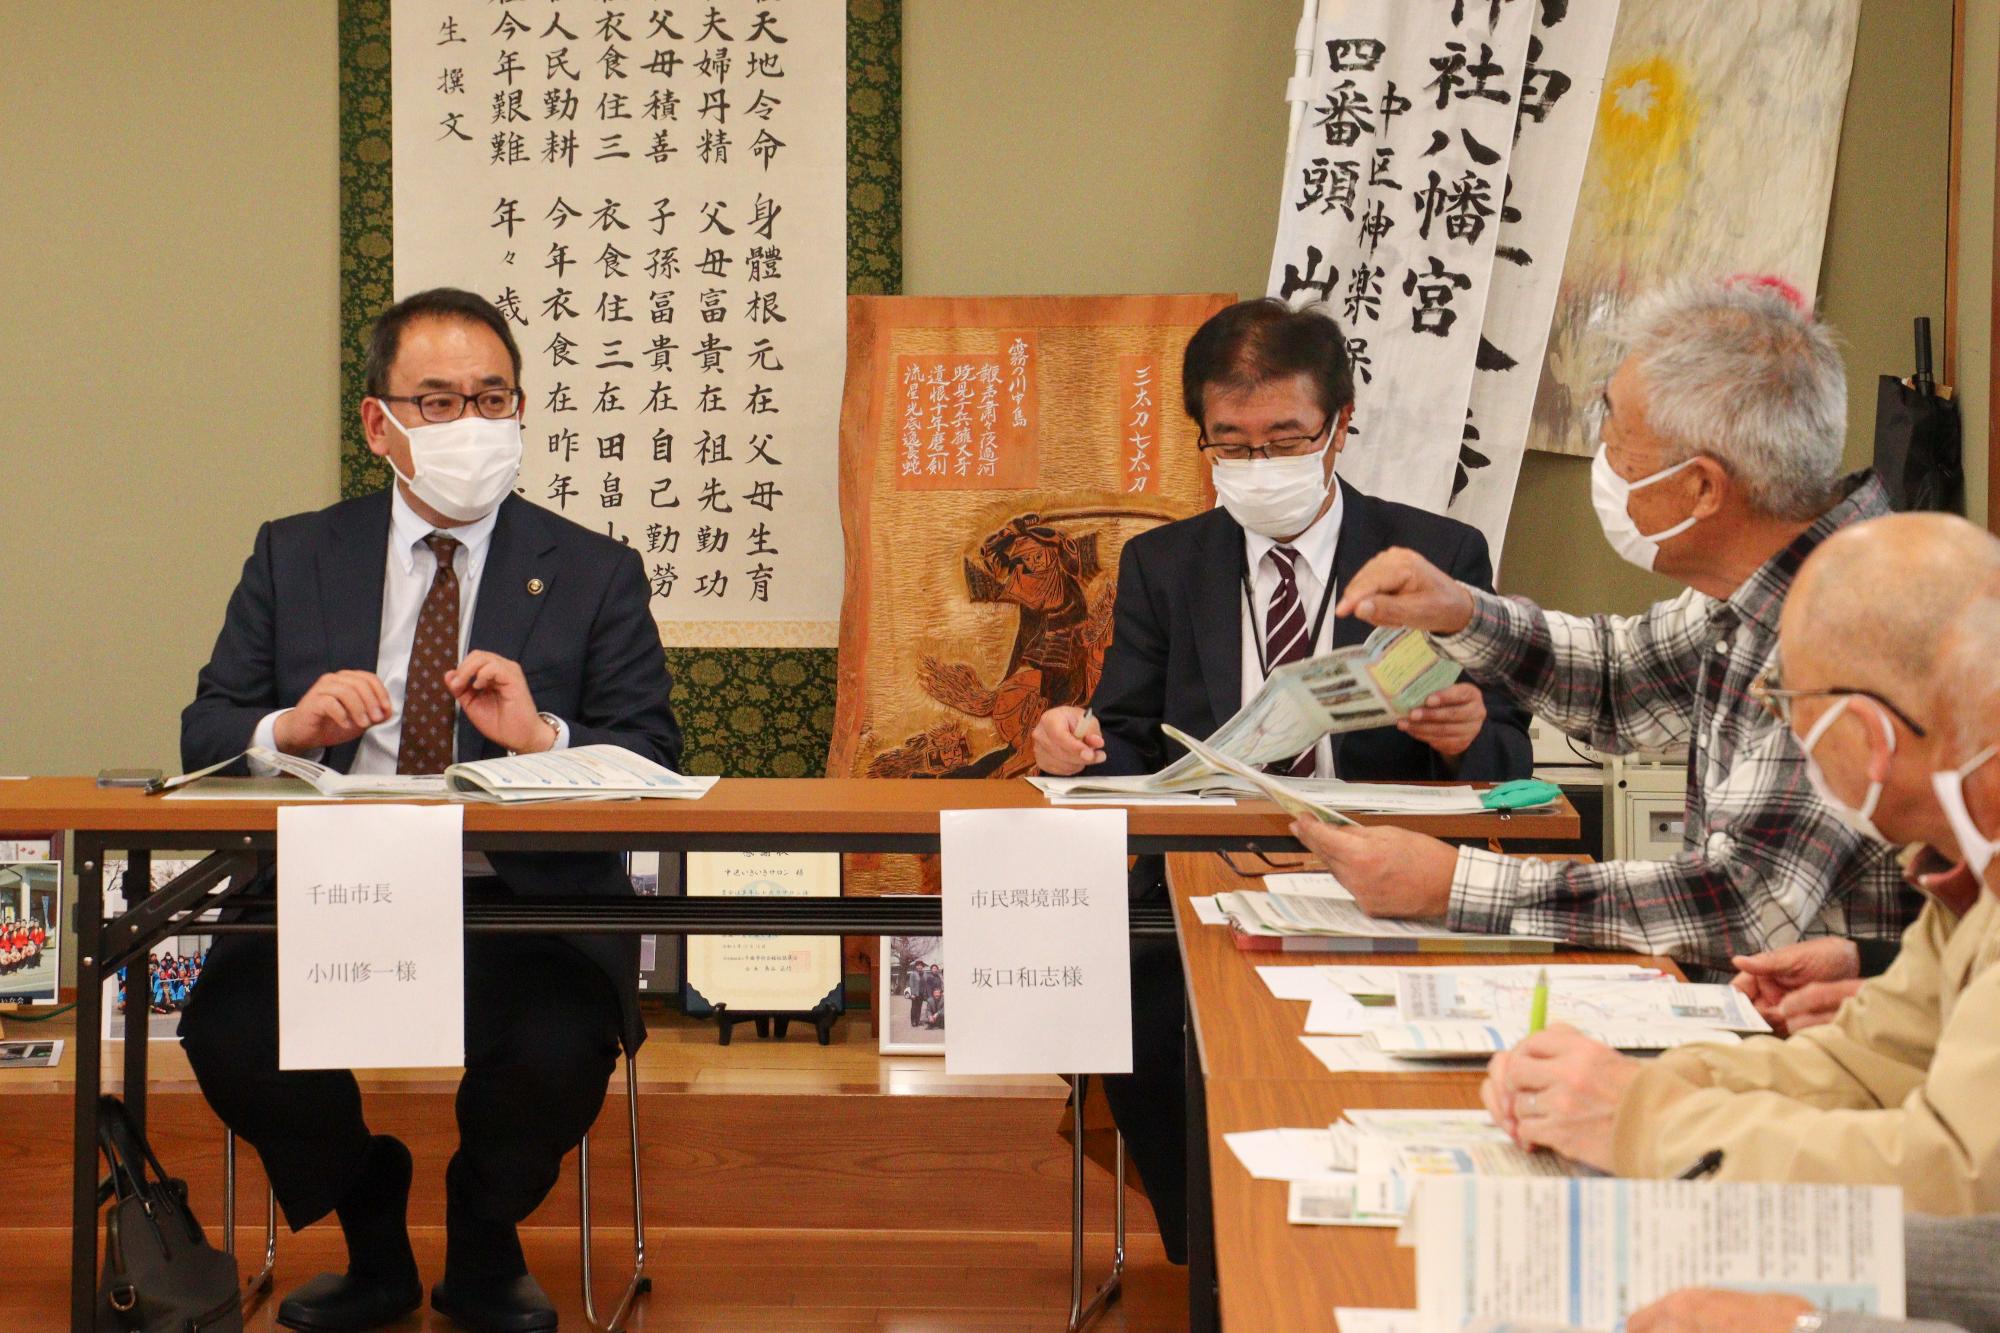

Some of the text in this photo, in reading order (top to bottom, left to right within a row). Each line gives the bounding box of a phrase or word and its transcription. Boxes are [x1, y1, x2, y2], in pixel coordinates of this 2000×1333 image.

[1128, 366, 1152, 494] 三太刀七太刀
[305, 883, 393, 905] 千曲市長
[970, 887, 1090, 909] 市民環境部長
[306, 960, 418, 984] 小川修一様
[971, 965, 1083, 988] 坂口和志様
